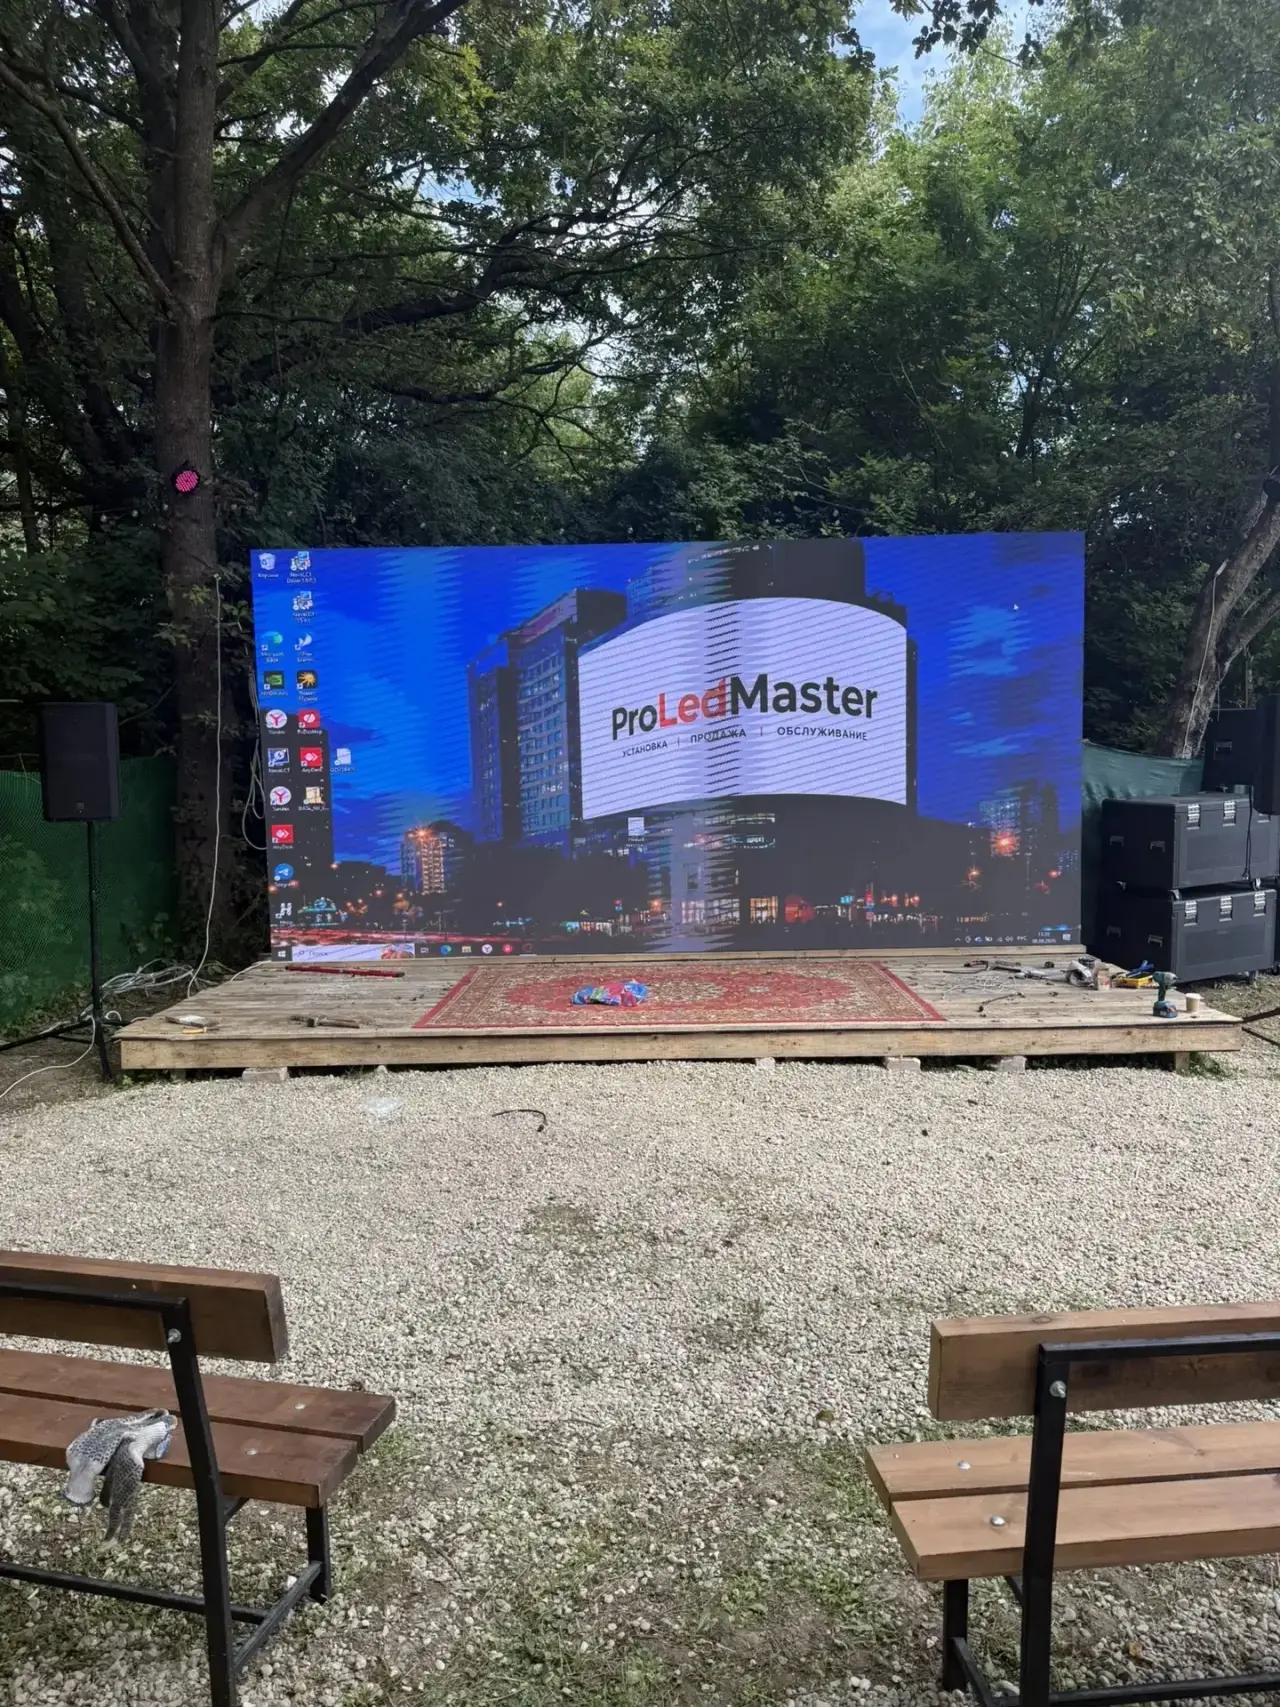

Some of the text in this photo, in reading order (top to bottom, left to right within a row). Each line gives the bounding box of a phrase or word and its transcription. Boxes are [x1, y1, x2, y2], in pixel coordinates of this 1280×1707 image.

[611, 673, 878, 741] ProLedMaster
[622, 726, 868, 758] УСТАНОВКА ПРОДАЖА ОБСЛУЖИВАНИЕ
